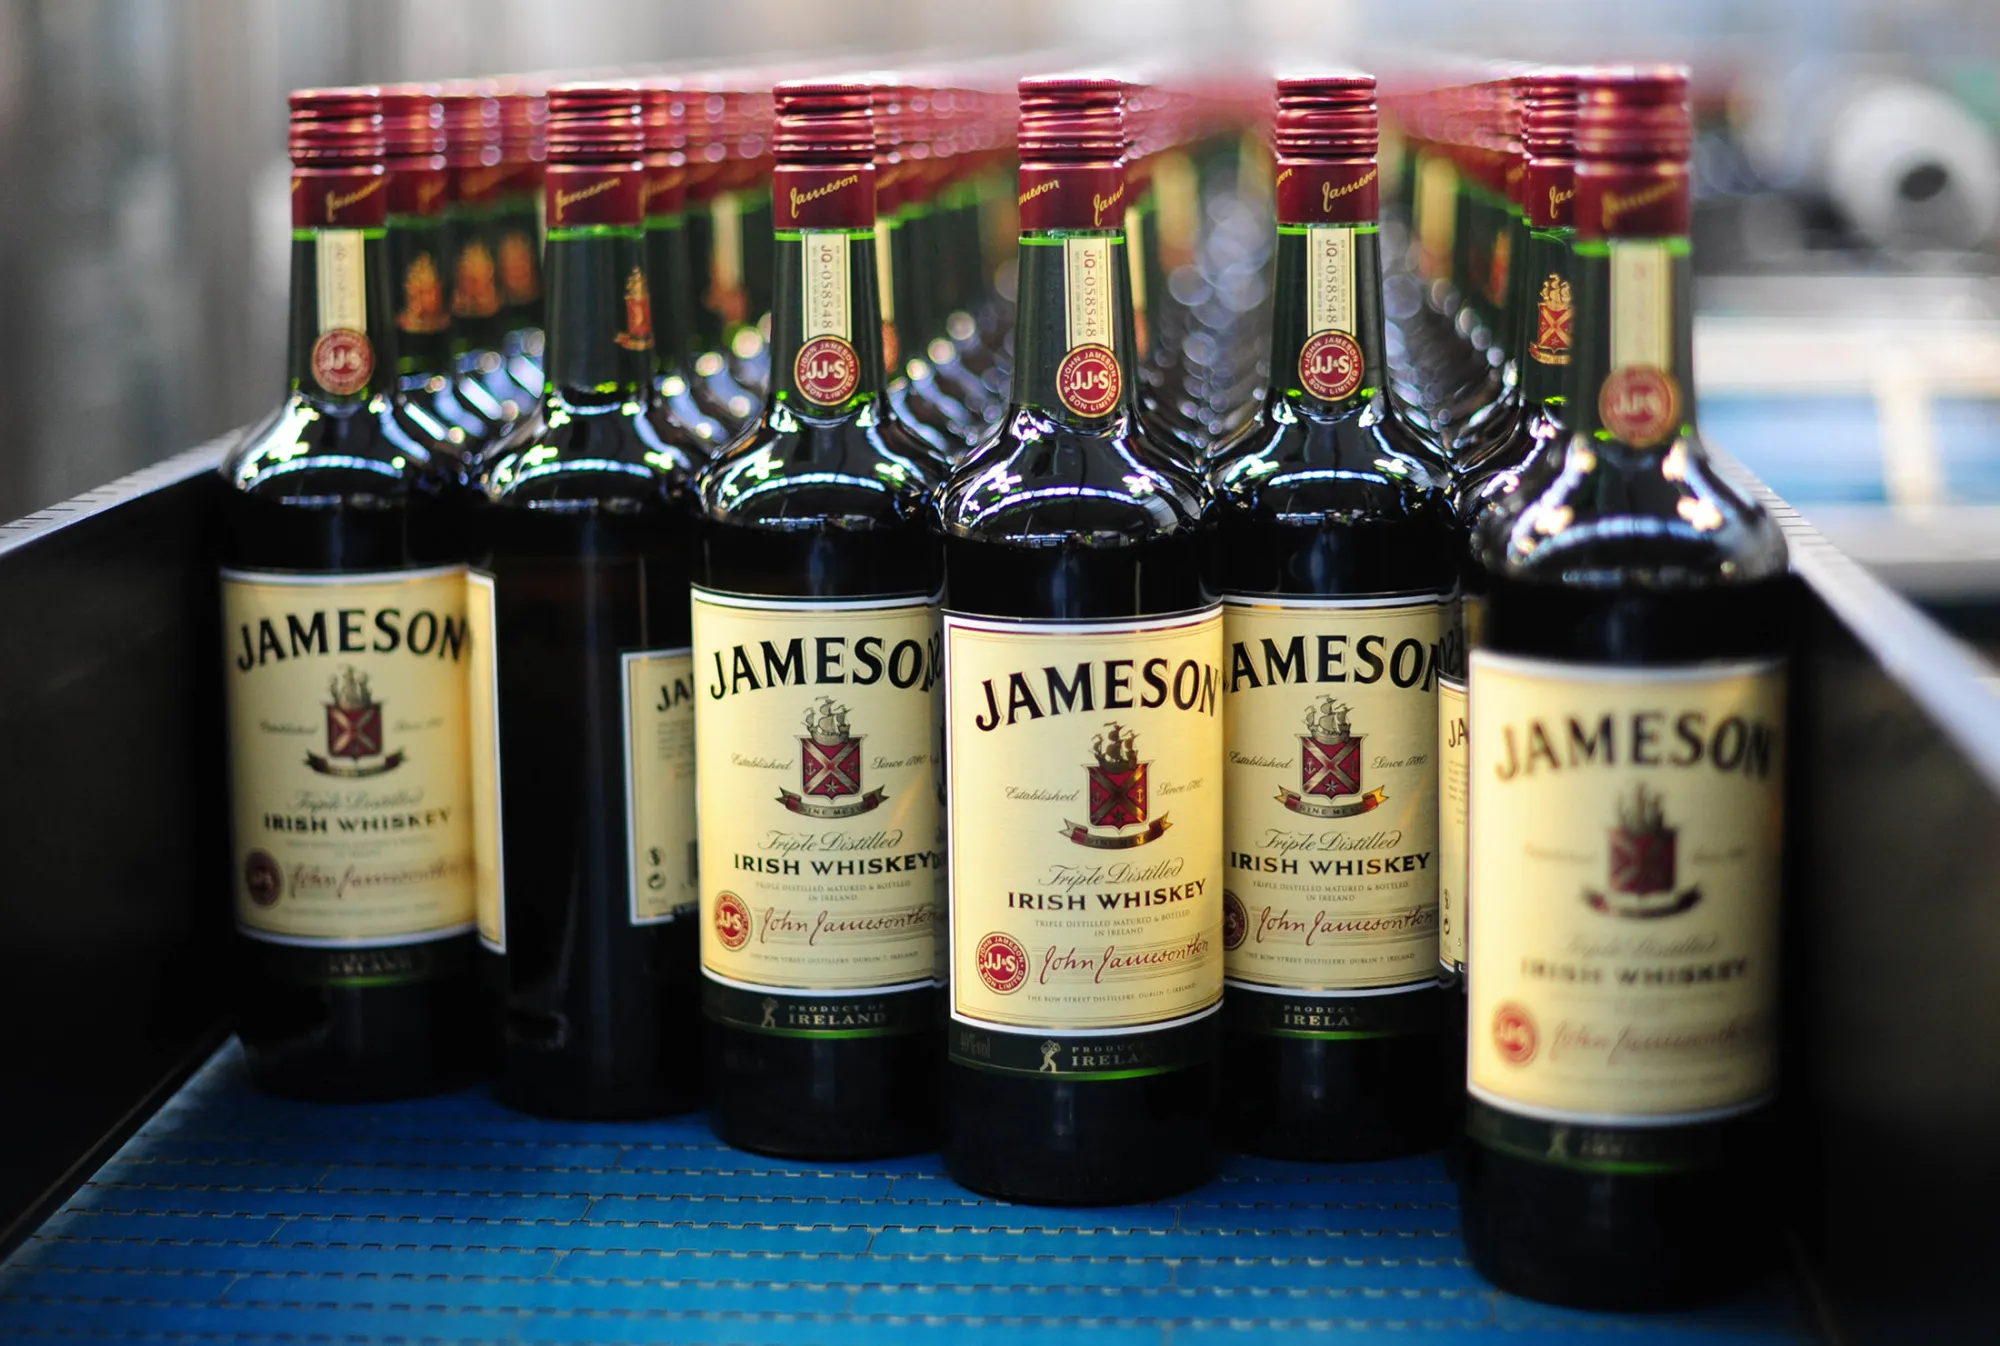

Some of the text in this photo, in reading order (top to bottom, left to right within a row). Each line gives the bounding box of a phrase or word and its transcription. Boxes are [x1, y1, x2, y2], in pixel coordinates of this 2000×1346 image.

[789, 172, 858, 219] Jameson
[1018, 178, 1060, 206] meson
[820, 244, 833, 329] JQ-058548
[1083, 249, 1097, 338] JQ-058548
[1325, 239, 1338, 325] JQ-058548
[820, 342, 855, 368] JAMESON
[1304, 337, 1358, 363] JOHN JAMESON
[805, 360, 846, 380] JJ&S
[1063, 351, 1117, 379] JOHN JAMESON
[1310, 355, 1350, 374] JJ&S
[1070, 370, 1108, 390] JJ&S
[1308, 378, 1326, 393] SON
[1329, 370, 1358, 395] LIMITED
[1068, 394, 1088, 410] SON
[1090, 385, 1117, 411] LIMITED
[235, 607, 470, 673] JAMESON
[657, 671, 694, 712] JA
[975, 657, 1219, 732] JAMESON
[1495, 709, 1778, 783] JAMESON
[730, 752, 795, 771] Established
[870, 756, 904, 771] Since
[1228, 751, 1294, 770] Established
[1371, 755, 1405, 770] Since
[1005, 785, 1081, 802] Established
[1156, 782, 1186, 797] Since
[263, 806, 452, 835] IRISH WHISKEY
[757, 828, 904, 857] Triple Distilled
[1255, 828, 1402, 857] Triple Distilled
[734, 850, 933, 876] IRISH WHISKEY
[1038, 856, 1185, 892] Triple Distilled
[1230, 851, 1431, 876] IRISH WHISKEY
[1008, 878, 1207, 911] IRISH WHISKEY
[1252, 880, 1277, 890] TRIPLE
[1280, 883, 1322, 892] DISTILLED
[1324, 883, 1364, 892] MATURED
[1374, 881, 1409, 891] BOTTLED
[1318, 894, 1355, 902] IRELAND
[760, 907, 808, 945] John
[1034, 919, 1063, 928] TRIPLE
[1066, 919, 1111, 928] DISTILLED
[1113, 916, 1152, 927] MATURED
[1161, 909, 1191, 921] BOTTLED
[1094, 926, 1144, 937] IN IRELAND
[1255, 905, 1305, 945] John
[980, 936, 1025, 963] JOHN JAMESON
[984, 952, 1016, 973] JJ&S
[1039, 945, 1094, 985] John
[983, 972, 997, 988] SON
[998, 969, 1025, 990] LIMITED
[788, 1004, 861, 1013] PRODUCT
[1063, 995, 1091, 1003] STREET
[1138, 990, 1164, 998] DUBLIN
[1283, 1004, 1357, 1013] PRODUCT
[788, 1012, 887, 1026] IRELAND
[1283, 1013, 1362, 1026] IRELA
[1071, 1053, 1152, 1067] IRELA
